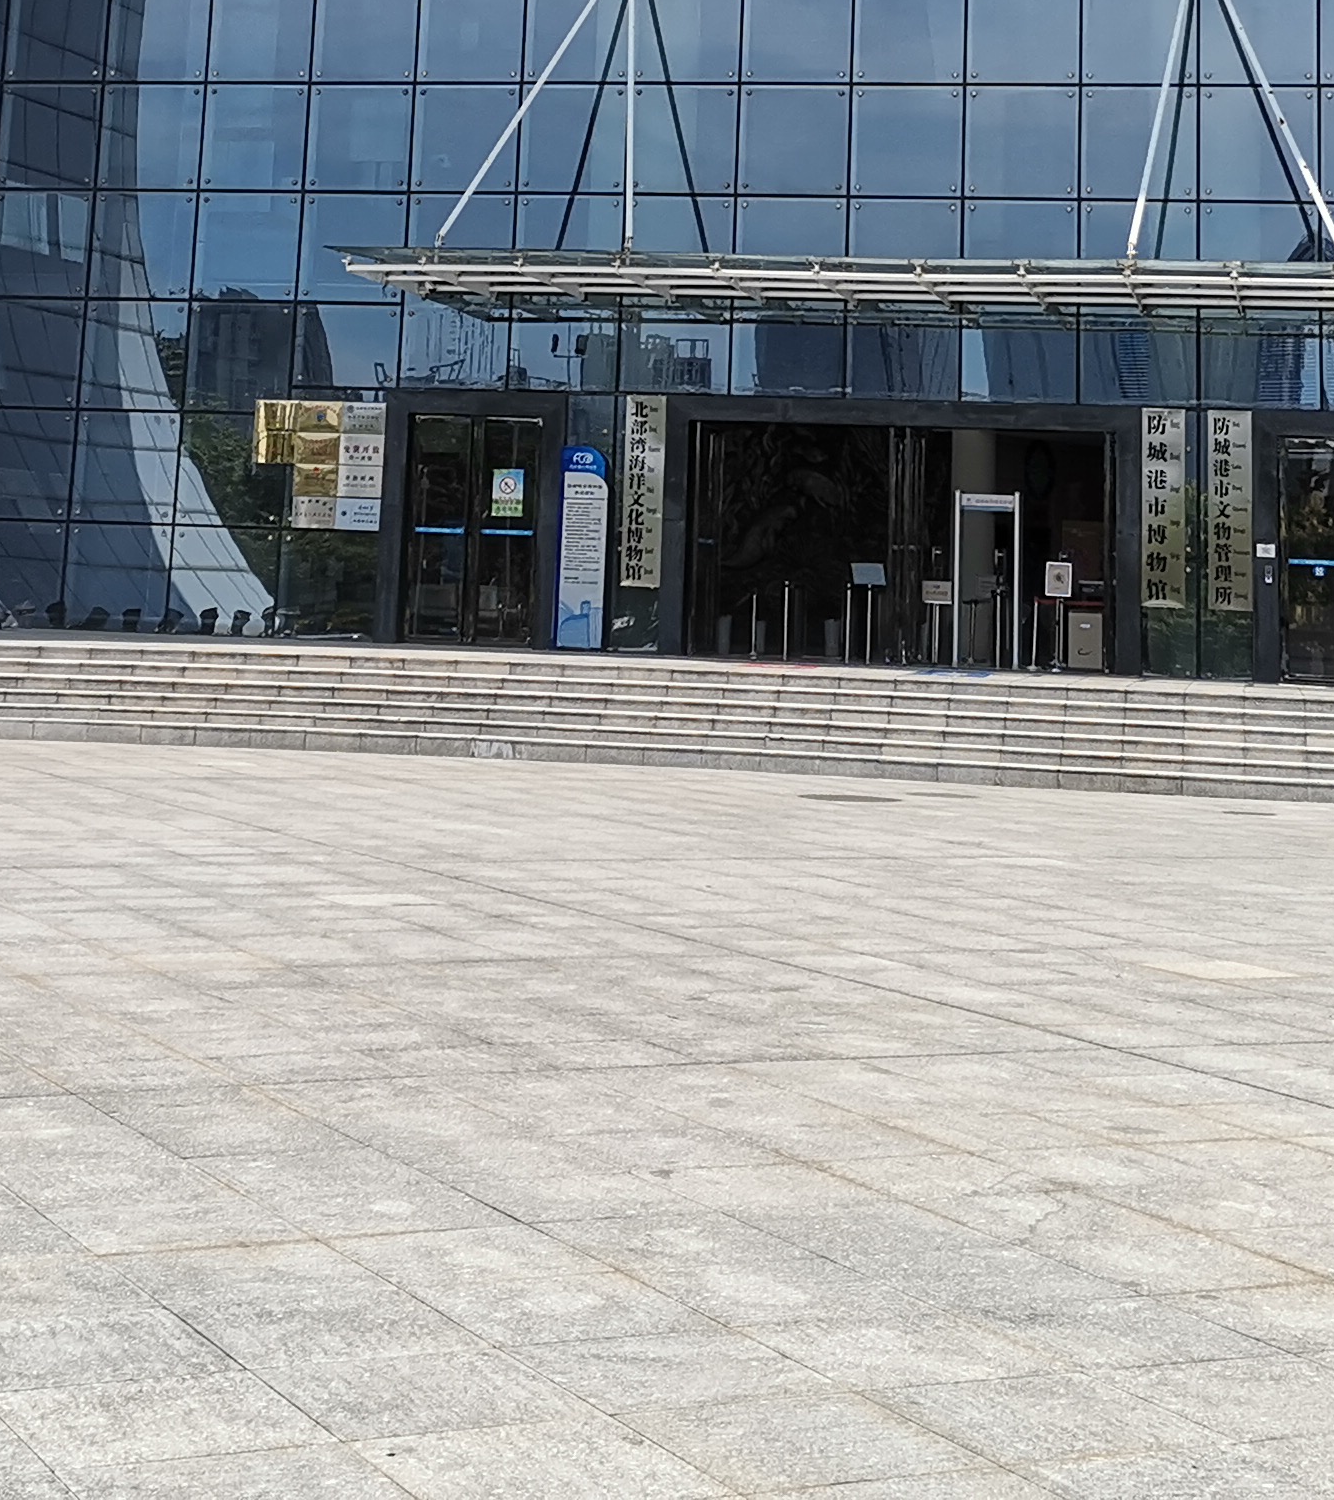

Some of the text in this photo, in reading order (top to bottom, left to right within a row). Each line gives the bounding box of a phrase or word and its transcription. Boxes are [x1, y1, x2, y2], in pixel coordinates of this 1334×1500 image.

[625, 401, 649, 581] 北部湾海洋文化博物馆
[1146, 414, 1168, 601] 防城港市博物馆
[1212, 417, 1233, 606] 防城港市文物管理所
